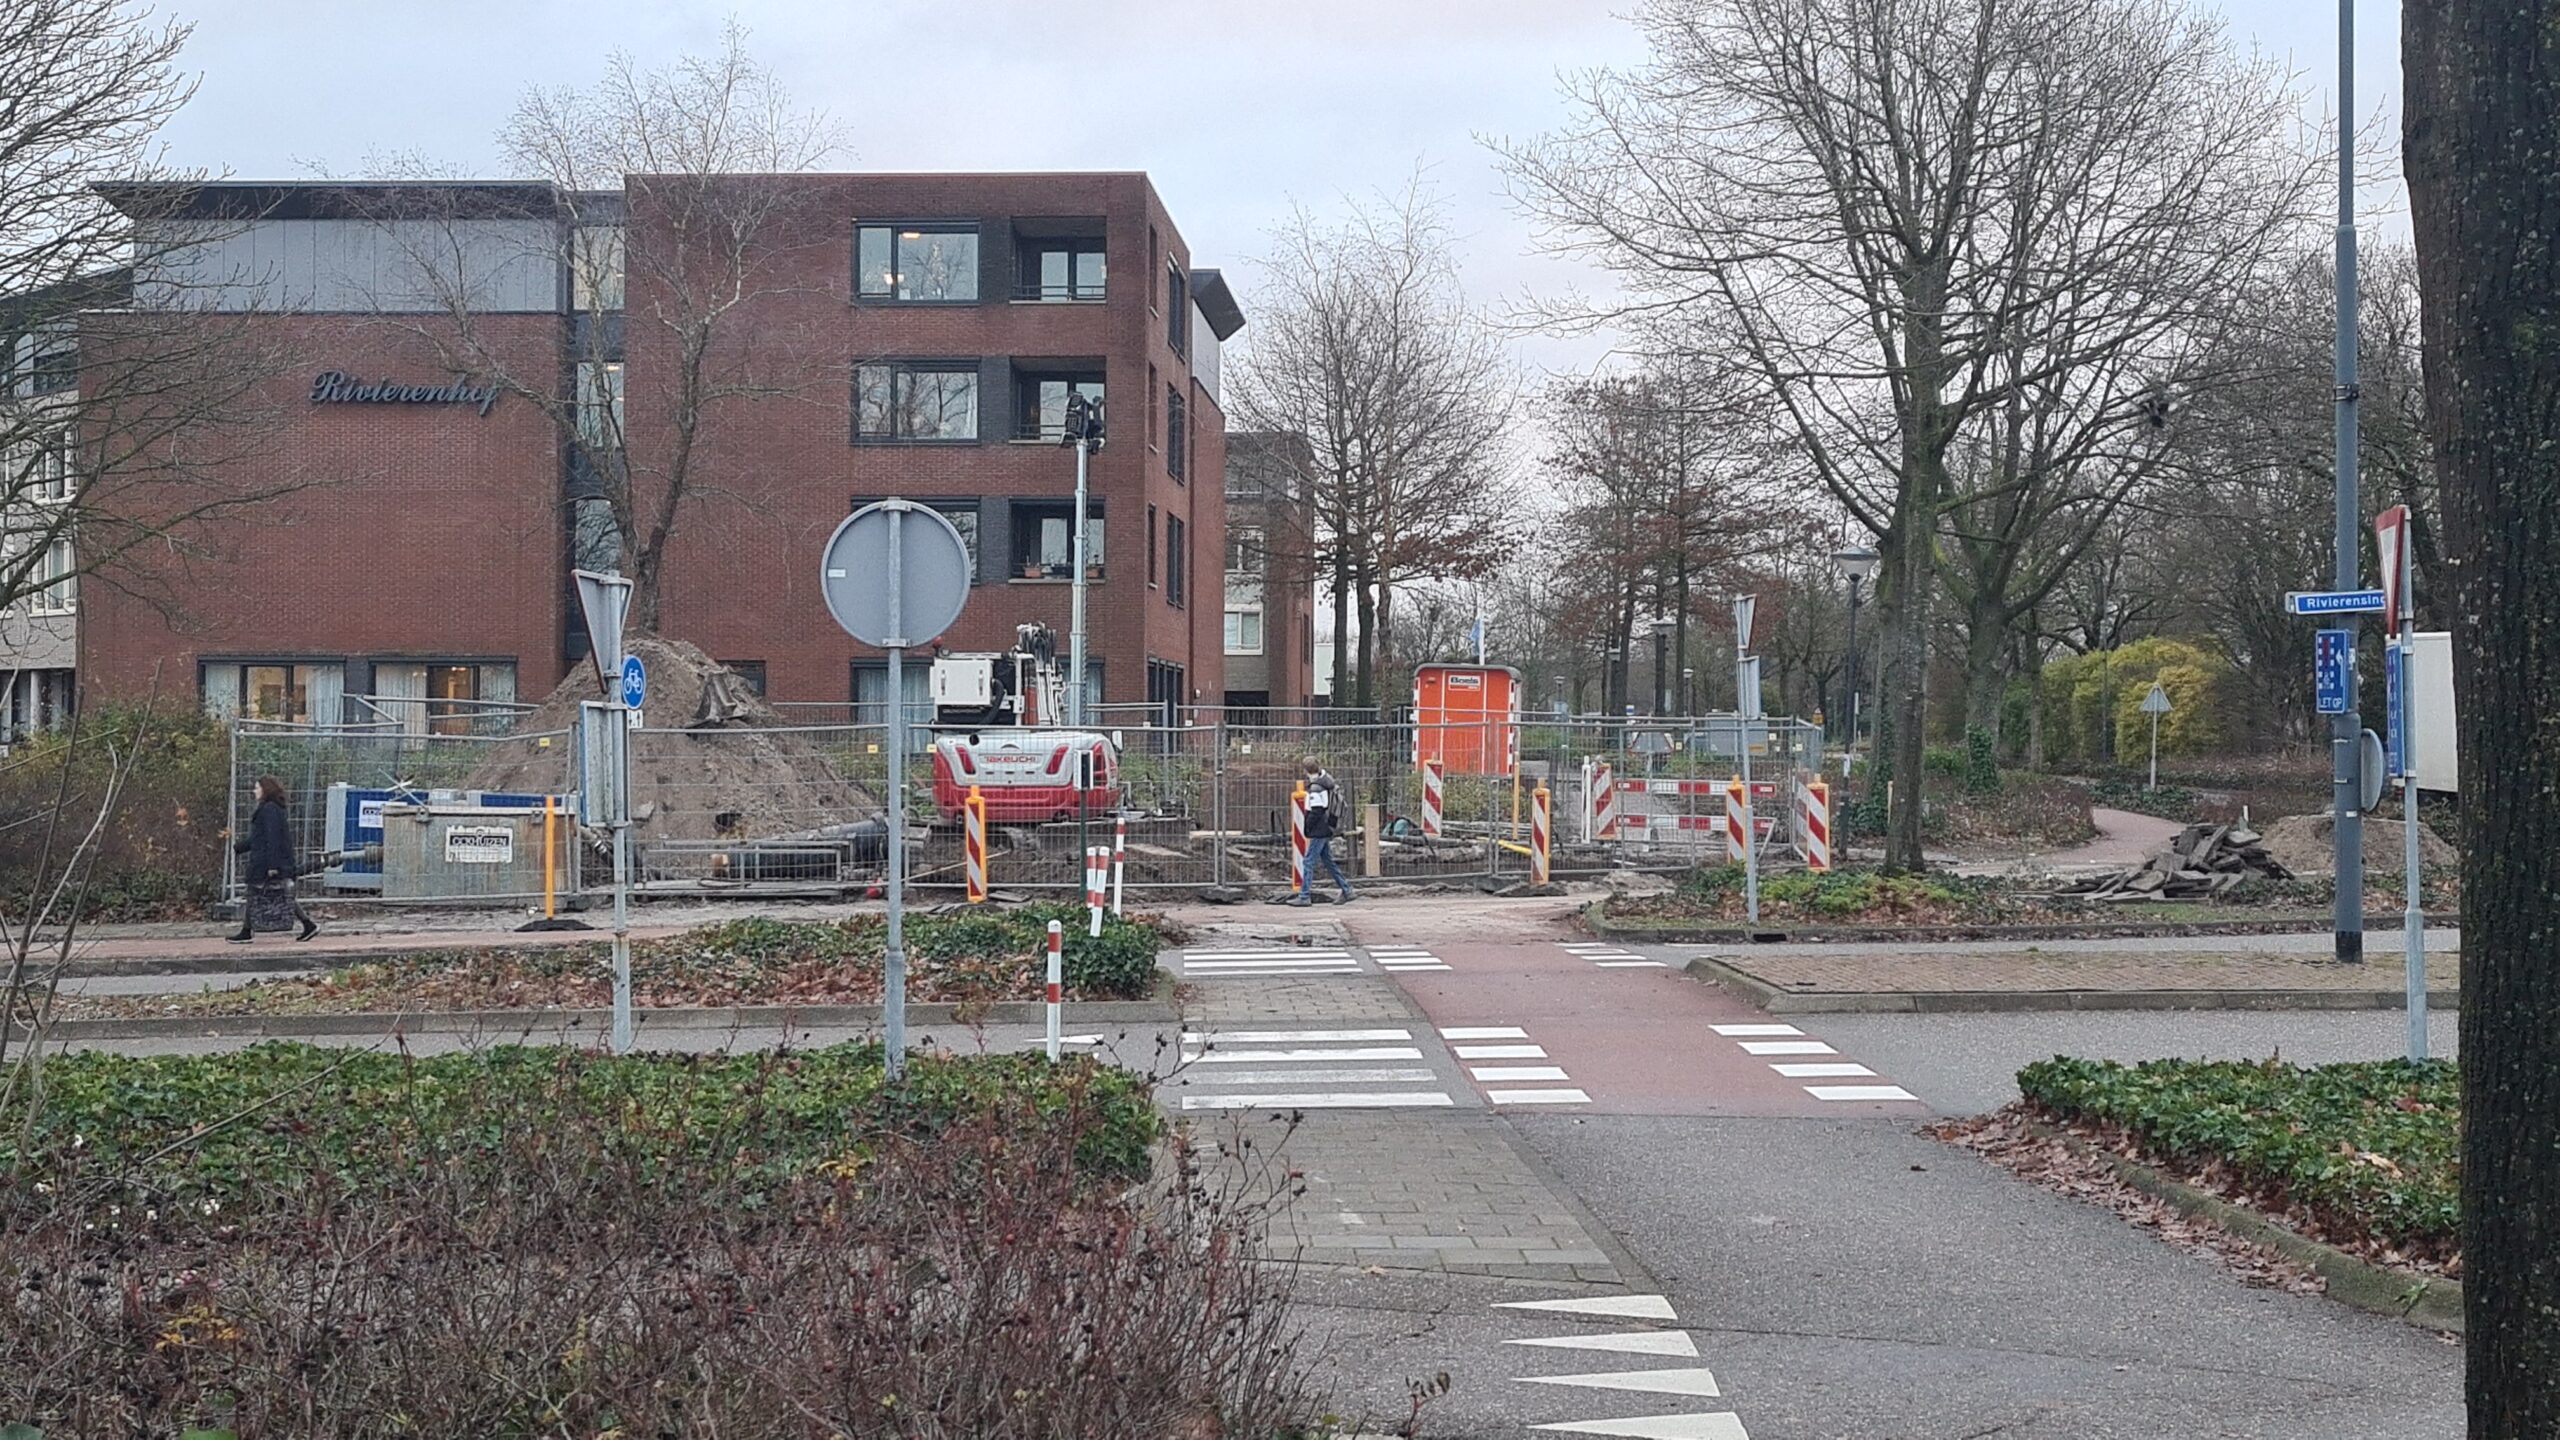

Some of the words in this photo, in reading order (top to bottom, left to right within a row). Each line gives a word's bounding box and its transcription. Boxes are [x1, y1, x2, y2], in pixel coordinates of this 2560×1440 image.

[309, 370, 498, 416] Rivierenhof
[2319, 697, 2331, 708] LET
[2333, 697, 2342, 708] OP
